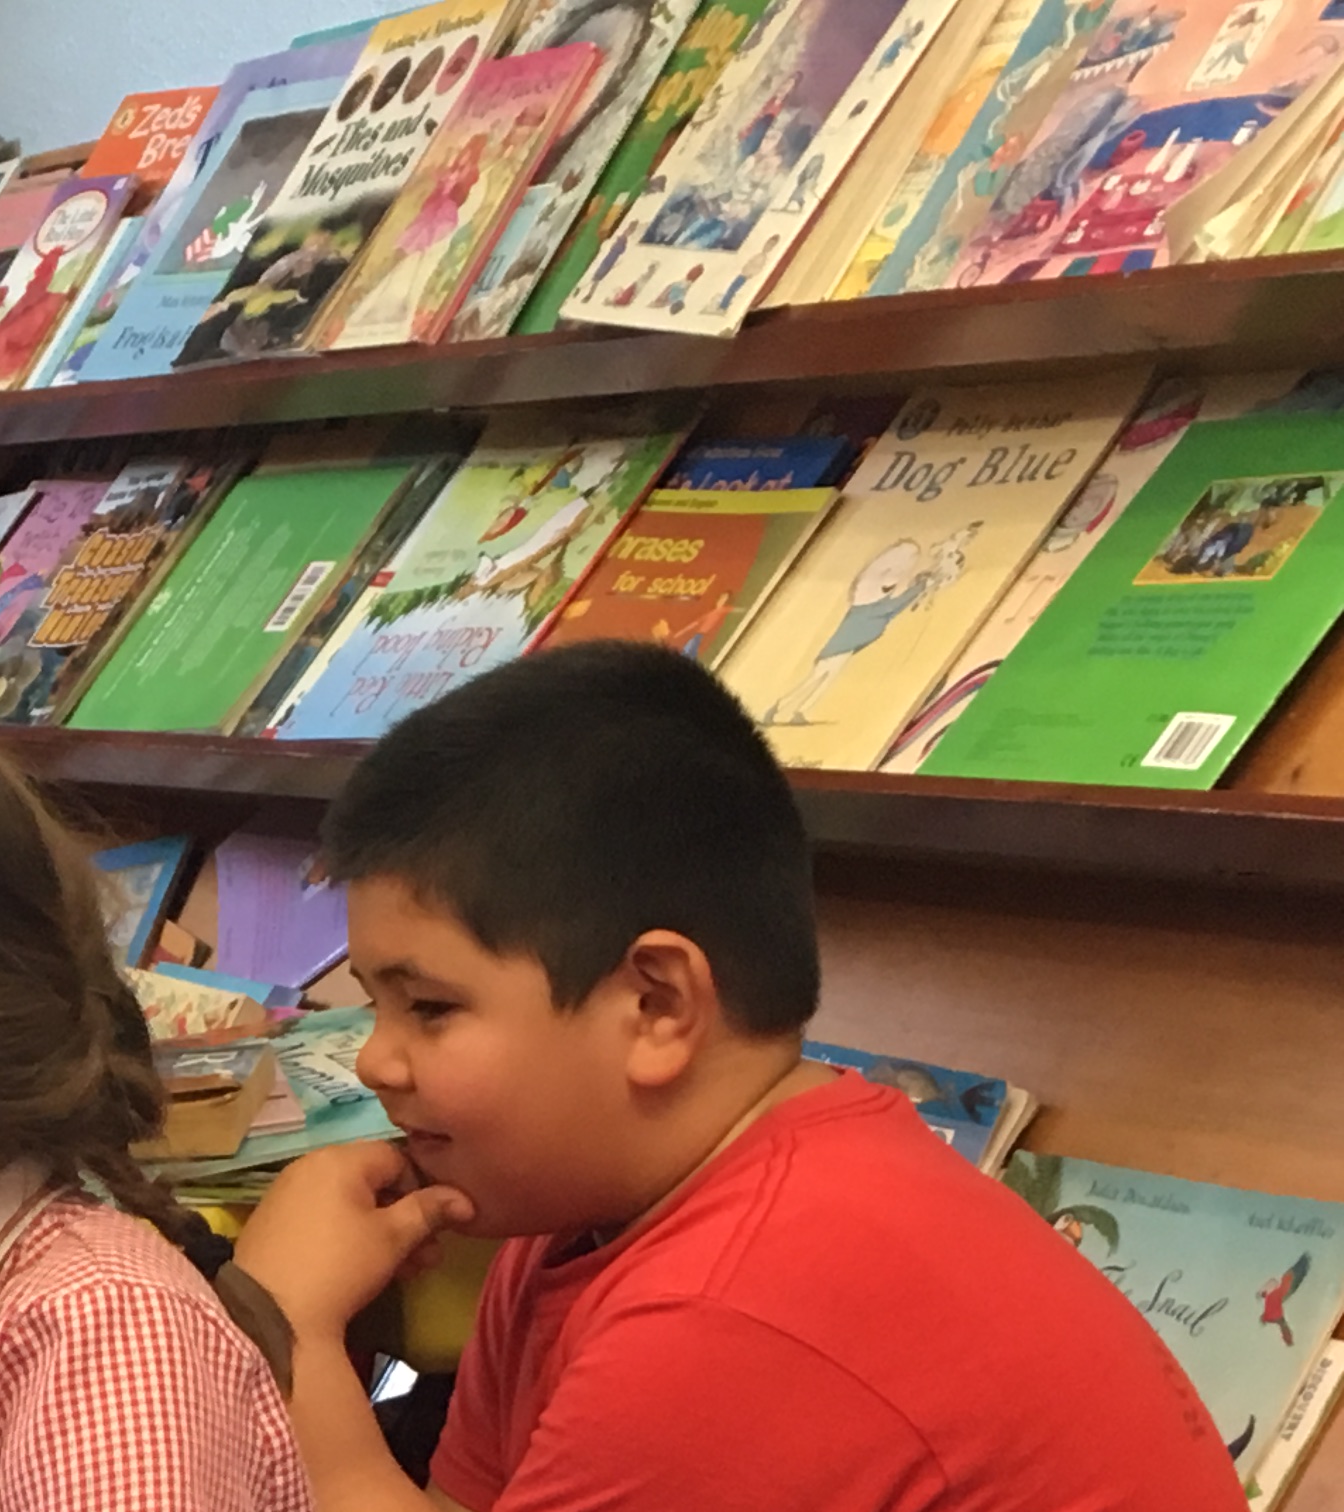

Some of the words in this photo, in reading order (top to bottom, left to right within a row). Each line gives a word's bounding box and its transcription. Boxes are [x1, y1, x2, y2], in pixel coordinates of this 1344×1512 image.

[128, 94, 203, 140] Zed's
[379, 103, 431, 143] and
[289, 147, 415, 201] Mosquitoes
[870, 450, 968, 503] Dog
[966, 443, 1078, 488] Blue
[608, 529, 705, 563] hrases
[612, 571, 645, 593] for
[647, 573, 717, 595] school
[1138, 1269, 1230, 1338] Snail
